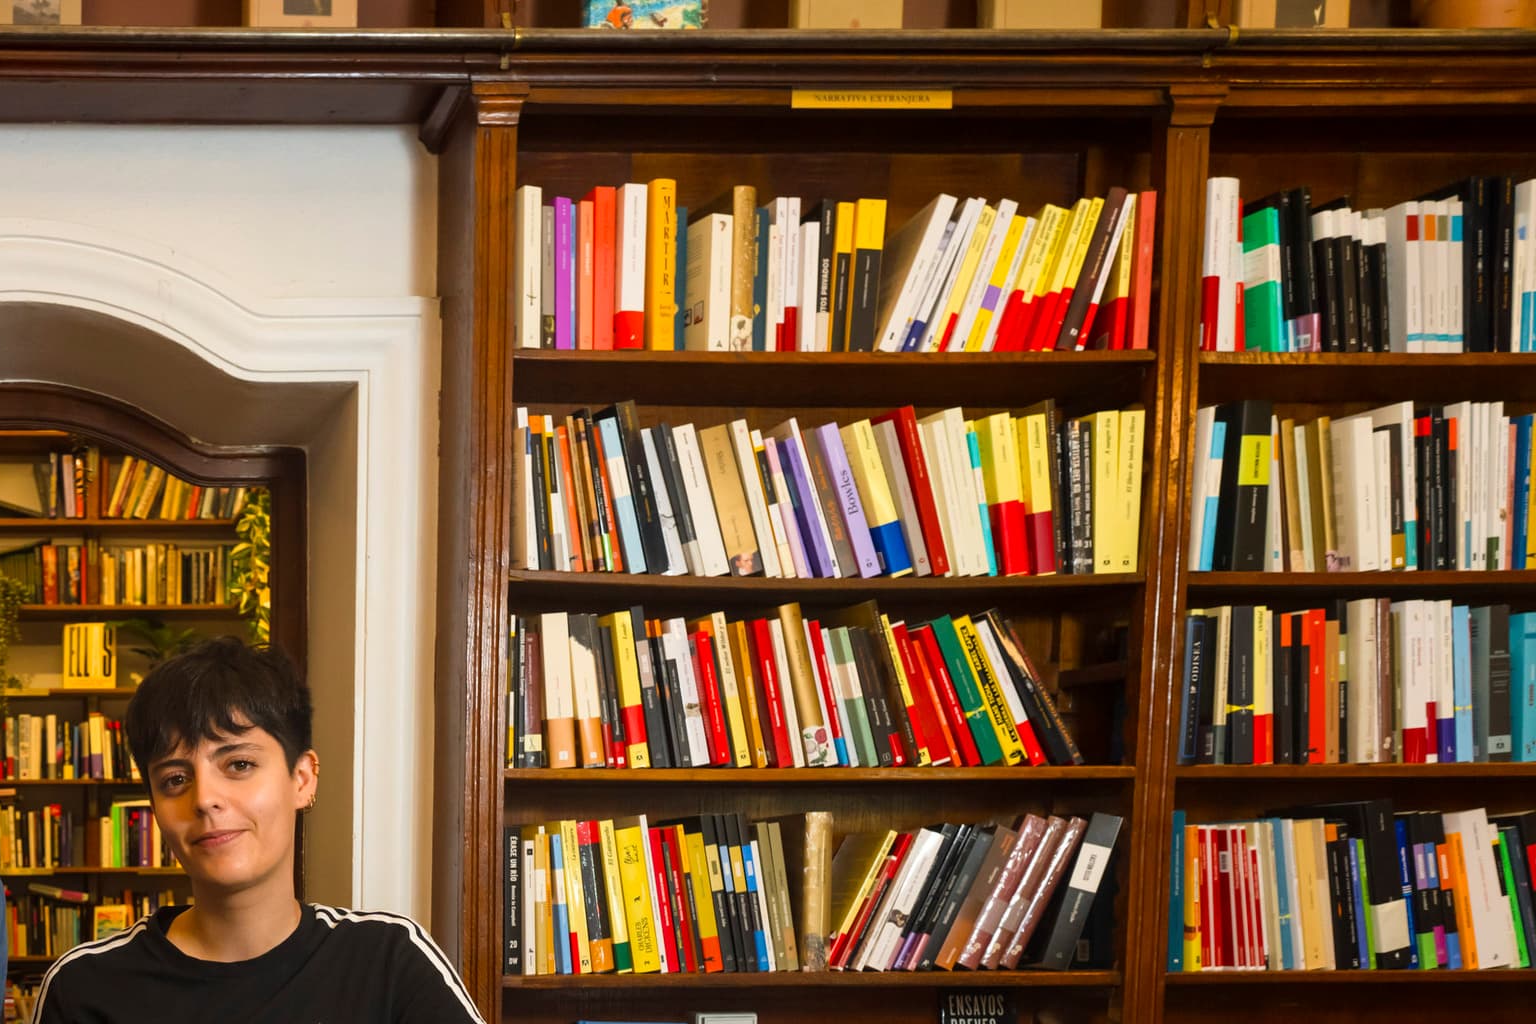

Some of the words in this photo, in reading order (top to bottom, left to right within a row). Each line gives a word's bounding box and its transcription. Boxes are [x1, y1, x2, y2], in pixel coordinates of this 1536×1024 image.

[815, 94, 868, 104] NARRATIVA
[840, 469, 859, 516] Bowles
[949, 995, 1005, 1017] ENSAYOS
